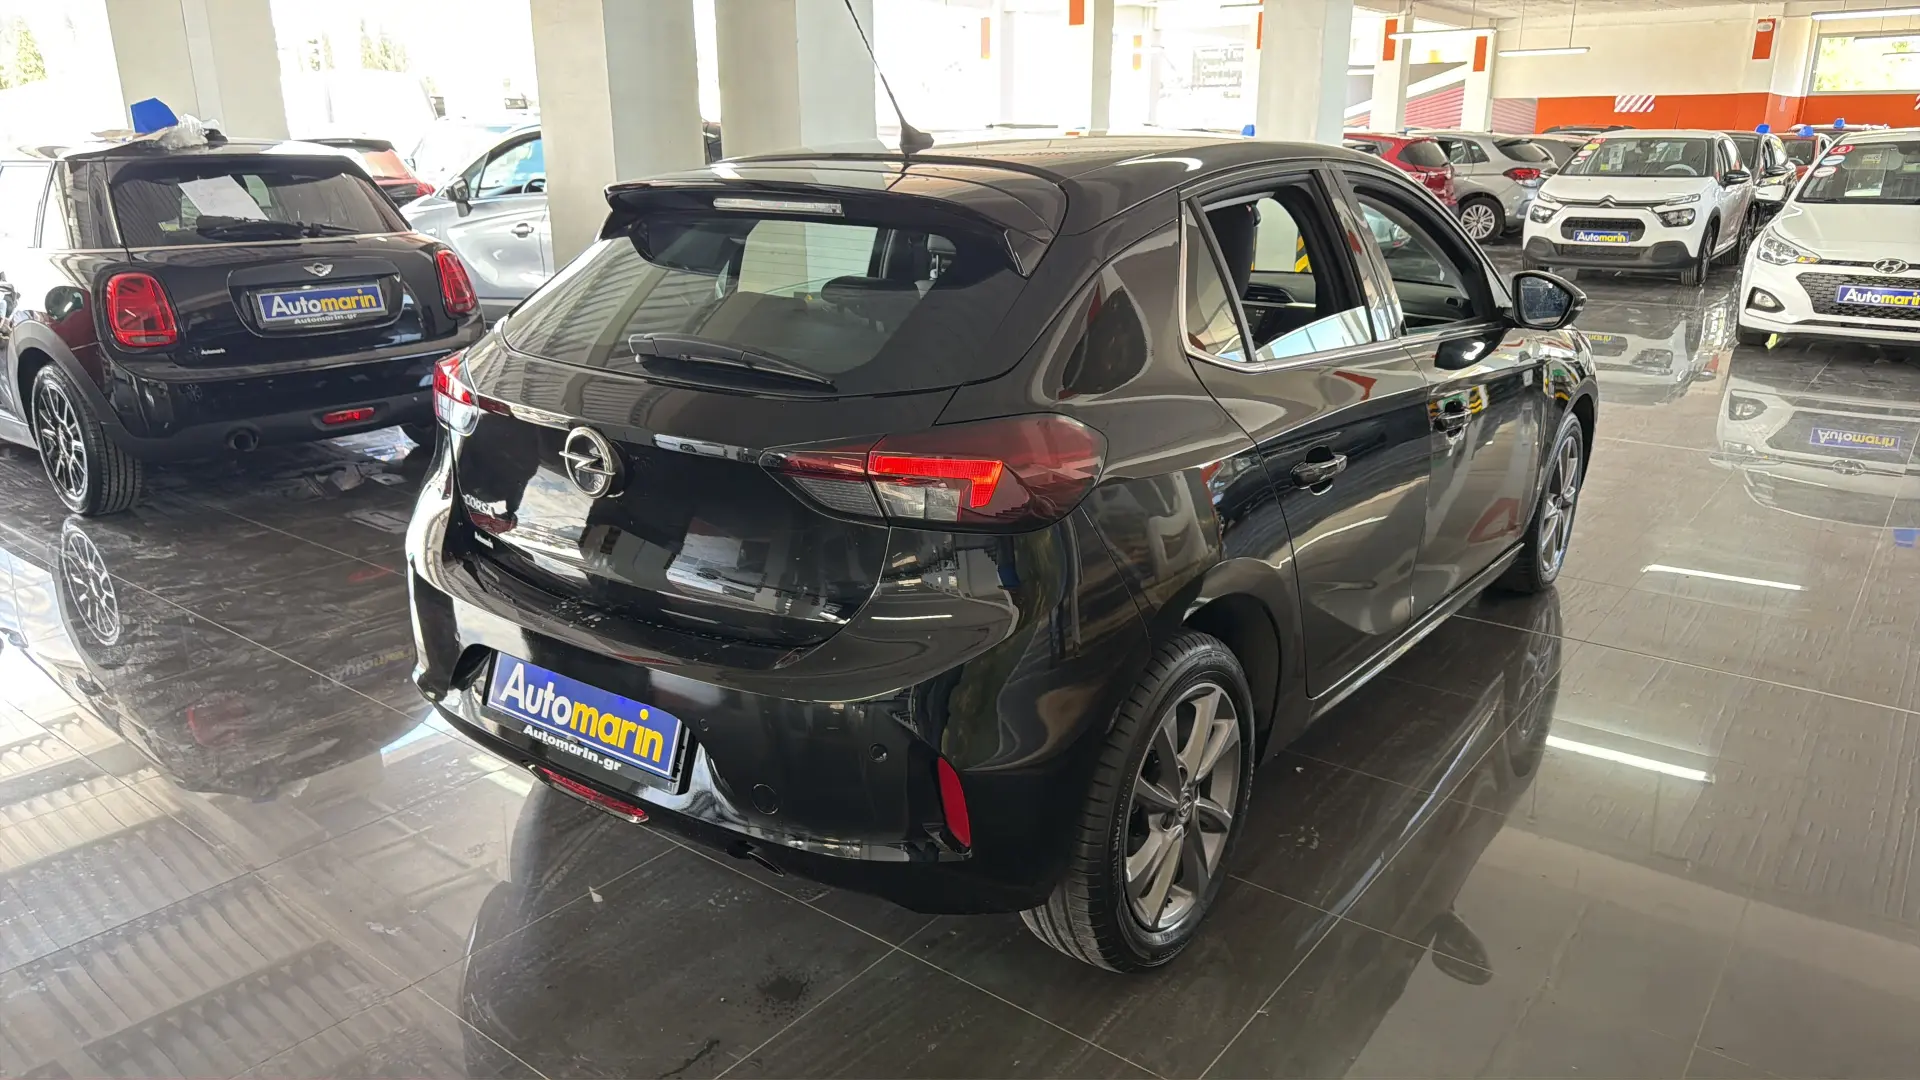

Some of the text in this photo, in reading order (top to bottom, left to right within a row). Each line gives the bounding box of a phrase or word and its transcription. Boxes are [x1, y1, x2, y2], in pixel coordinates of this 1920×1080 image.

[1576, 231, 1626, 242] Automarin
[271, 288, 377, 317] Automarin
[1842, 288, 1920, 306] Automari
[294, 313, 358, 325] Automarin.gr
[462, 493, 496, 520] CORSA
[499, 662, 664, 763] Automarin
[523, 724, 622, 771] Automarin.gr
